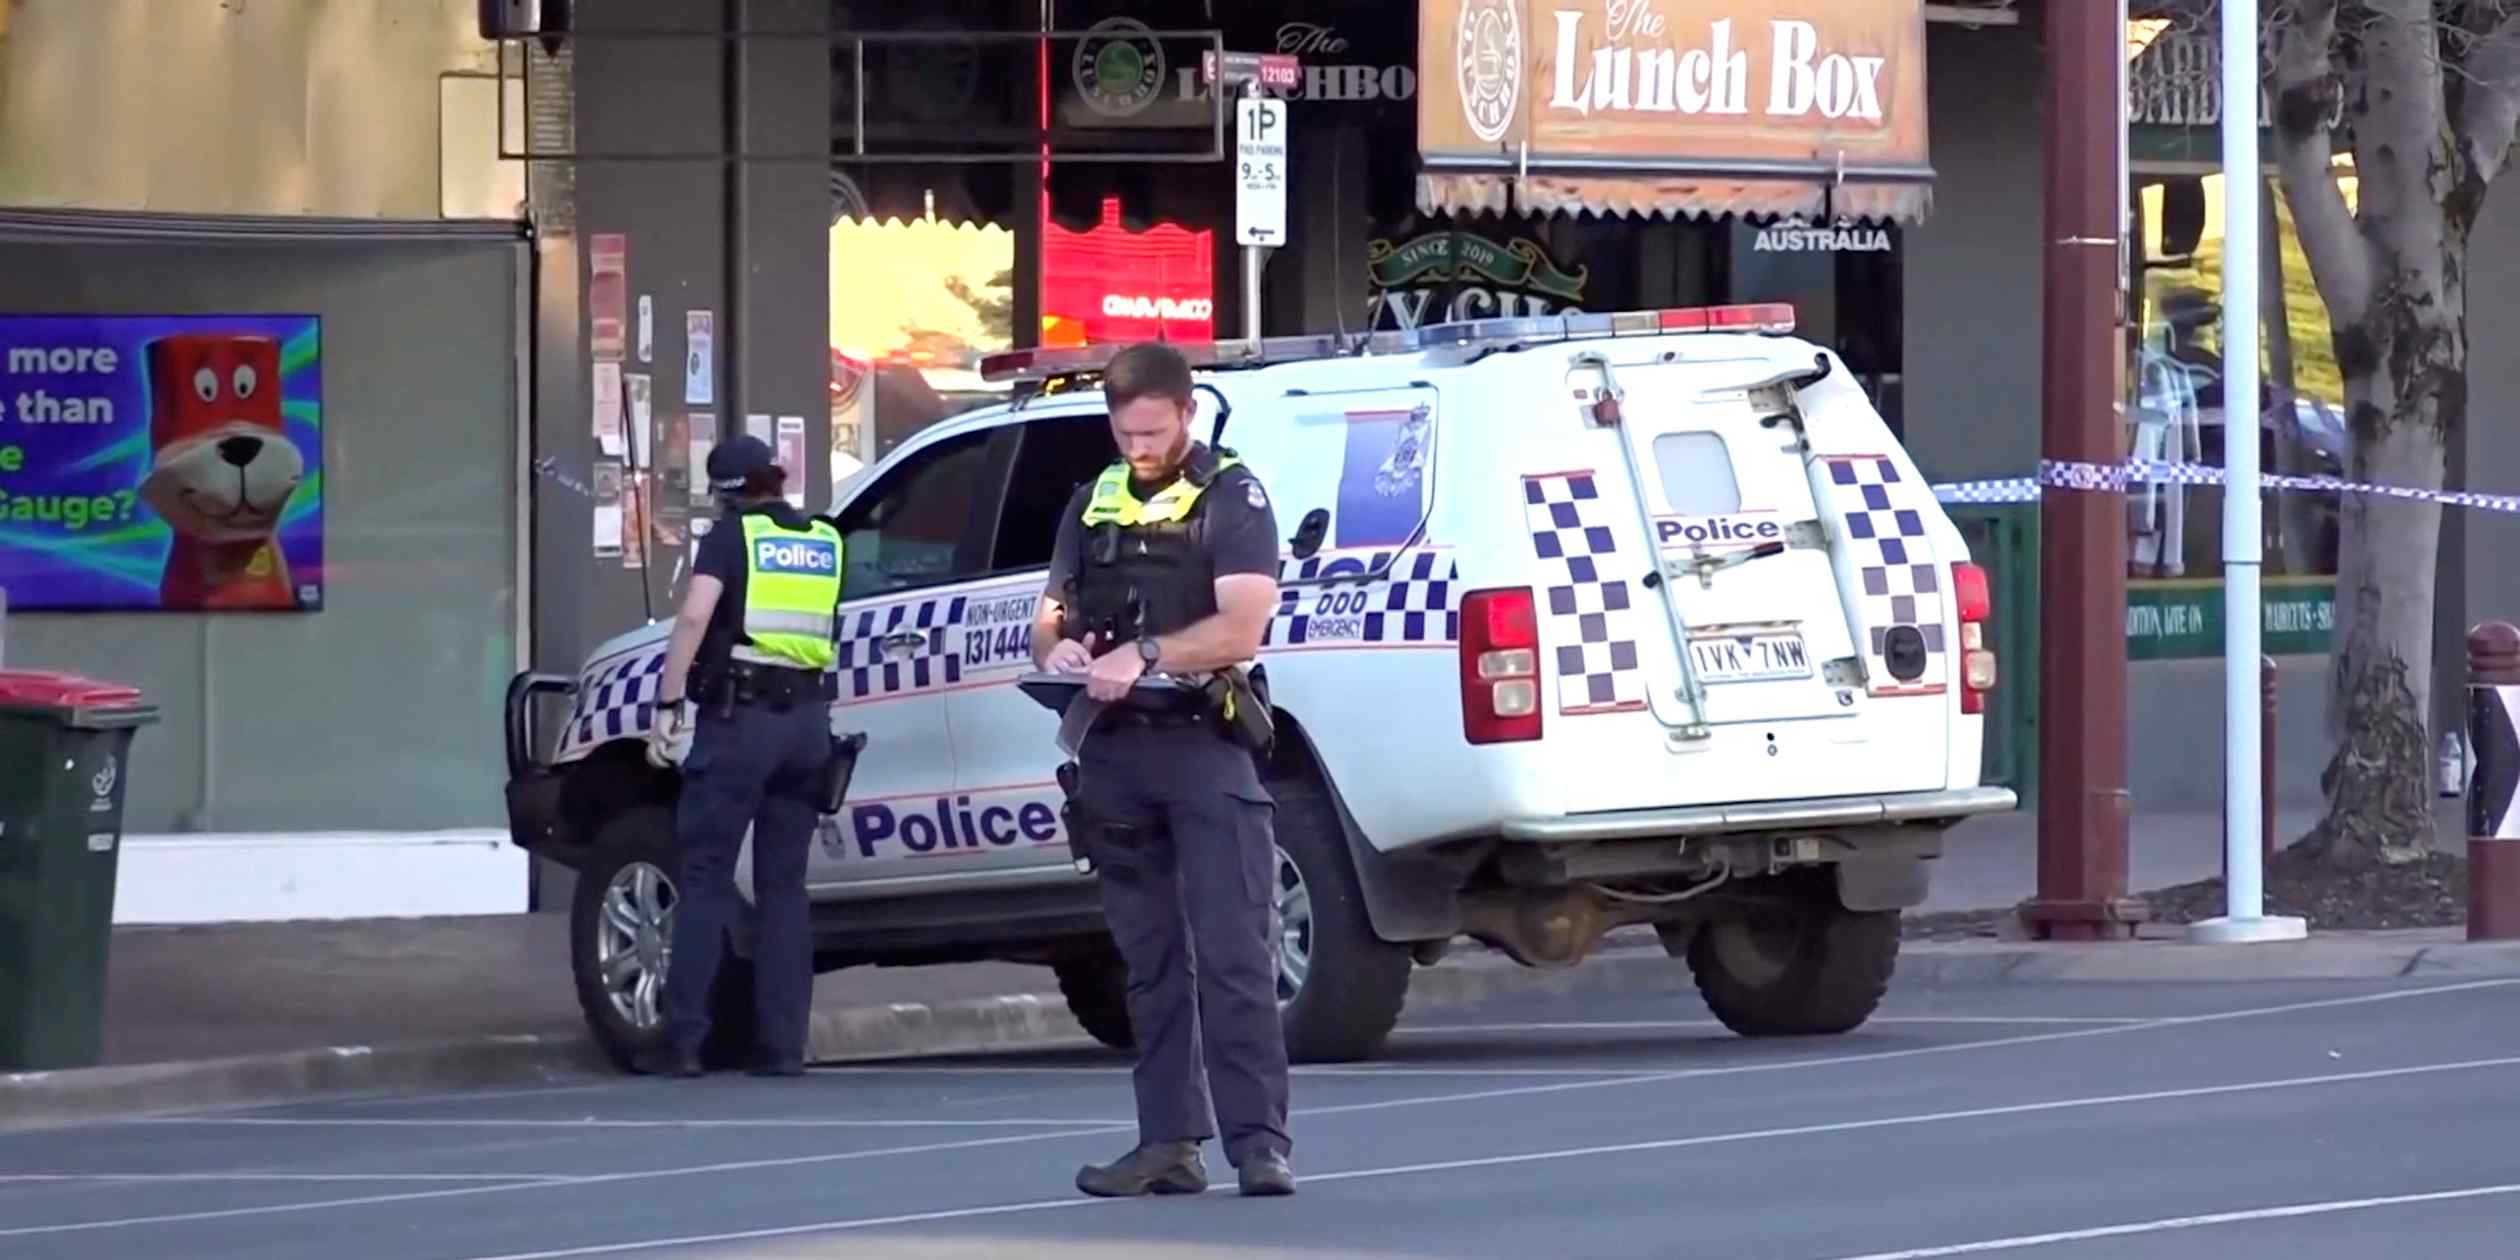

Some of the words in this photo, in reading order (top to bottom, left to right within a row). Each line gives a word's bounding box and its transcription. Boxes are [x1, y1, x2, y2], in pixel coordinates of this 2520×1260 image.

[1605, 0, 1666, 41] The
[1549, 10, 1748, 117] Lunch
[1765, 19, 1886, 123] Box
[1247, 101, 1276, 140] 1P
[1401, 238, 1448, 266] SINCE
[1461, 240, 1495, 265] 2019
[1753, 229, 1892, 251] AUSTRALIA
[8, 347, 119, 373] more
[16, 389, 114, 423] than
[1656, 517, 1780, 543] Police
[757, 542, 833, 570] Police
[966, 596, 1037, 627] NON-URGENT
[1316, 590, 1367, 615] 000
[1308, 616, 1361, 639] EMERGENCY
[965, 628, 992, 665] 131
[994, 623, 1031, 660] 444
[852, 795, 1057, 857] Police
